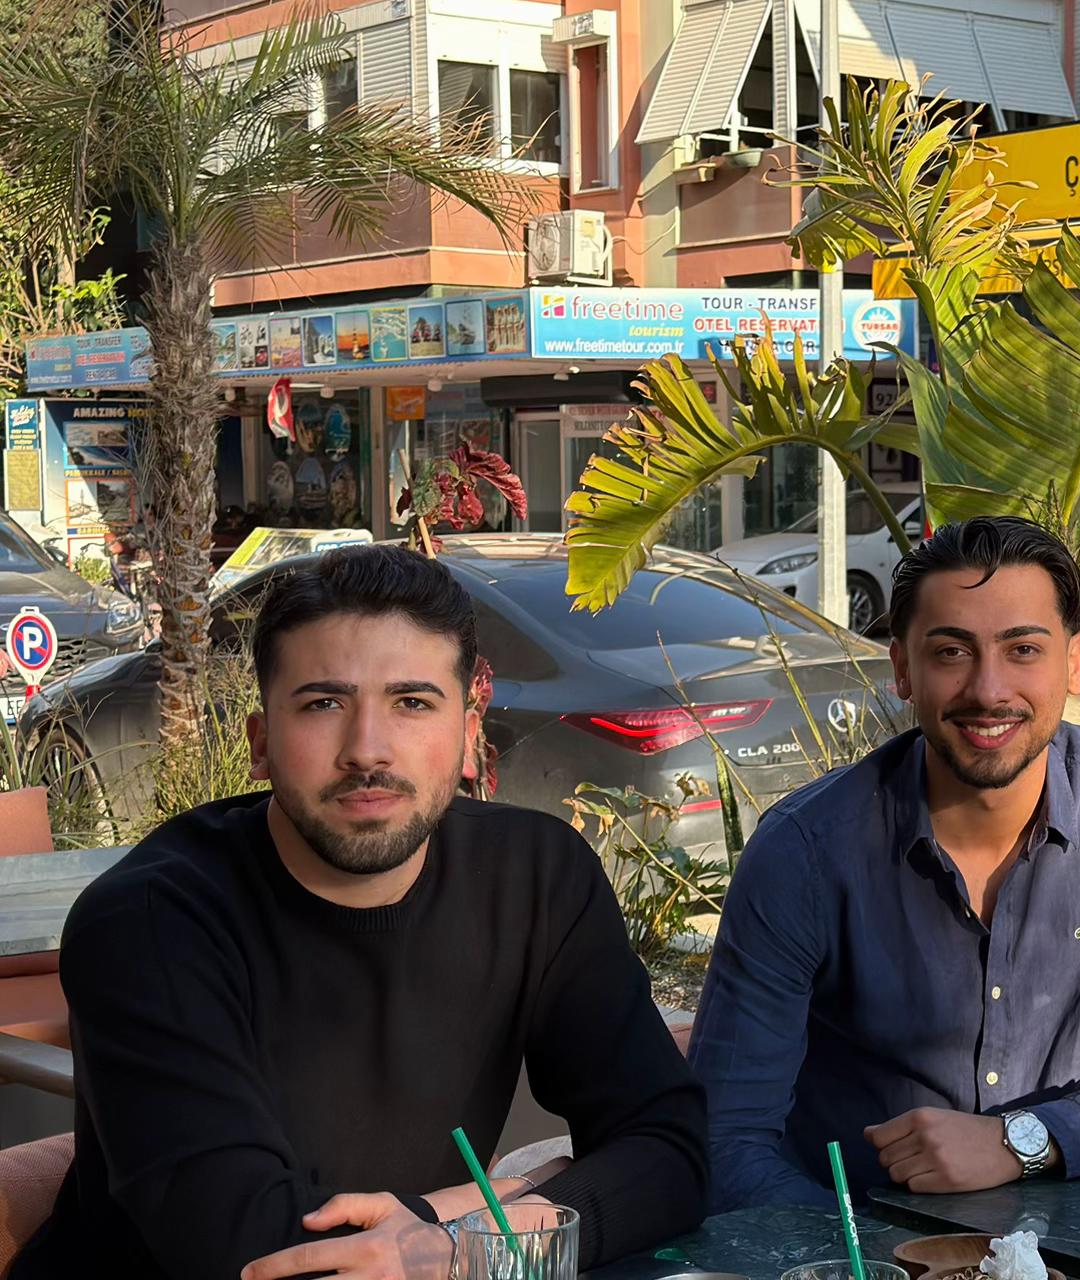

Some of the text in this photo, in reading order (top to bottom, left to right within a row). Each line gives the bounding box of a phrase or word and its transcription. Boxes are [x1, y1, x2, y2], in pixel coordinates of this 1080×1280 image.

[572, 295, 683, 320] freetime
[701, 297, 743, 310] TOUR
[757, 297, 817, 310] TRANSF
[628, 322, 684, 337] tourism
[694, 318, 845, 332] OTEL RESERVAT
[544, 337, 685, 354] www.freetimetour.com.tr
[784, 339, 816, 354] CR
[73, 407, 126, 418] AMAZING
[22, 626, 43, 660] P
[737, 743, 801, 757] CLA 200
